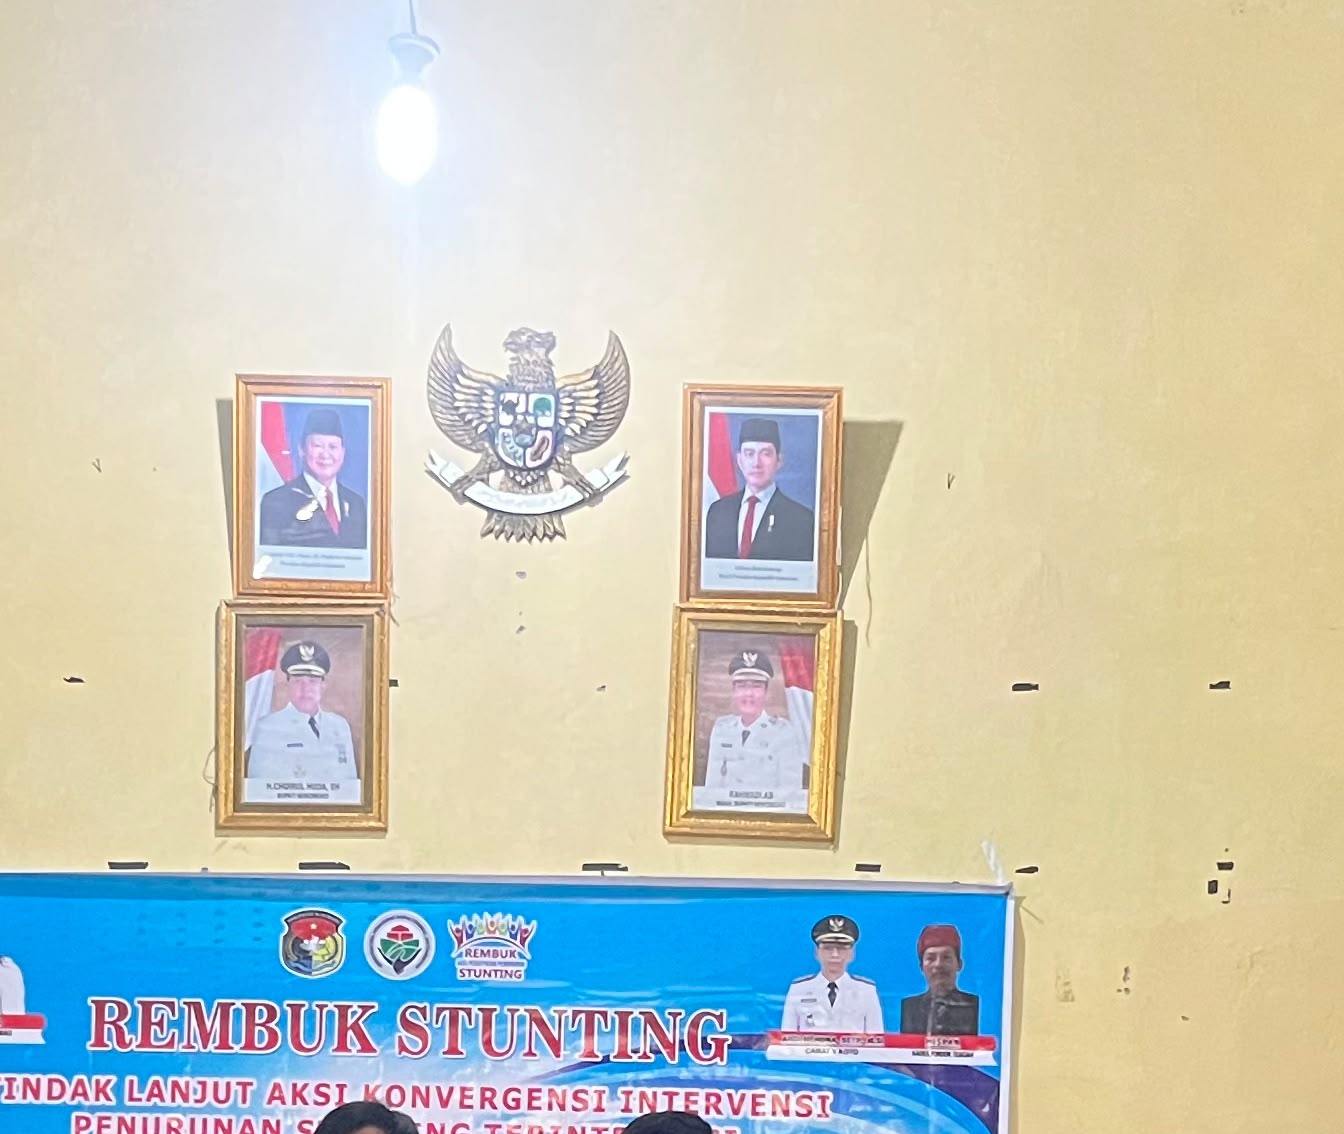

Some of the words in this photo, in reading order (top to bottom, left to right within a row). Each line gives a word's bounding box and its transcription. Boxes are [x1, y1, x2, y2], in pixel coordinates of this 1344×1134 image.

[464, 948, 517, 959] REMBUK
[459, 968, 523, 979] STUNTING
[89, 997, 379, 1055] REMBUK
[396, 1003, 730, 1063] STUNTING
[127, 1078, 254, 1105] LANJUT
[266, 1082, 348, 1106] AKSI
[363, 1084, 606, 1114] KONVERGENSI
[620, 1089, 832, 1118] INTERVENSI
